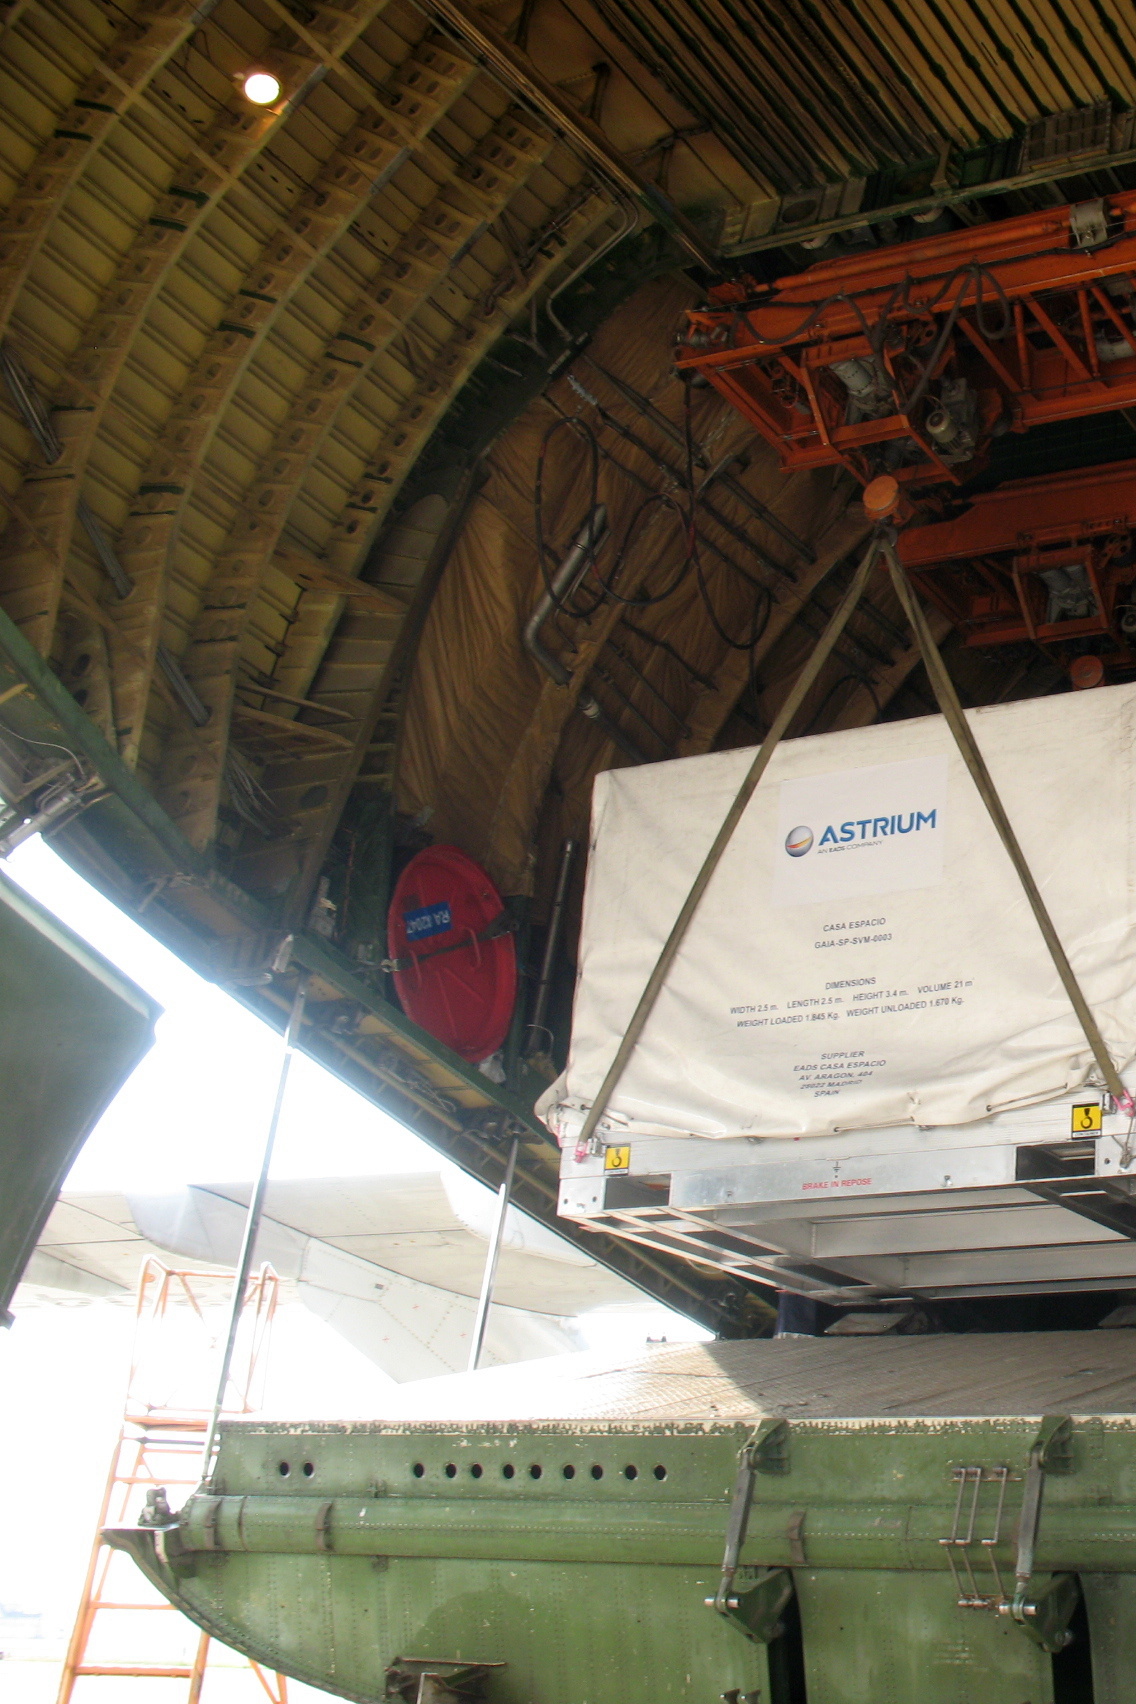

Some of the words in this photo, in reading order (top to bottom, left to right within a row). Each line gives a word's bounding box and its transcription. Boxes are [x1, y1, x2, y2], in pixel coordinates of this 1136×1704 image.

[819, 809, 937, 846] ASTRIUM
[823, 922, 846, 932] CASA
[849, 917, 886, 929] ESPACIO
[815, 934, 892, 949] GAIA-SP-SVM-0003
[825, 977, 876, 990] DIMENSIONS
[730, 1006, 755, 1015] WIDTH
[757, 1004, 768, 1012] 2.5
[787, 998, 819, 1009] LENGTH
[821, 997, 832, 1005] 2.5
[853, 991, 884, 1002] HEIGHT
[886, 989, 897, 998] 3.4
[918, 983, 952, 994] VOLUME
[954, 980, 963, 988] 21
[737, 1018, 768, 1028] WEIGHT
[770, 1015, 804, 1025] LOADED
[847, 1006, 879, 1017] WEIGHT
[881, 1000, 927, 1015] UNLOADED
[821, 1051, 864, 1060] SUPPLIER
[793, 1063, 818, 1072] EADS
[820, 1061, 845, 1070] CASA
[847, 1059, 886, 1068] ESPACIO
[814, 1088, 839, 1097] SPAIN
[802, 1181, 829, 1190] BRAKE
[841, 1177, 872, 1187] REPOSE
